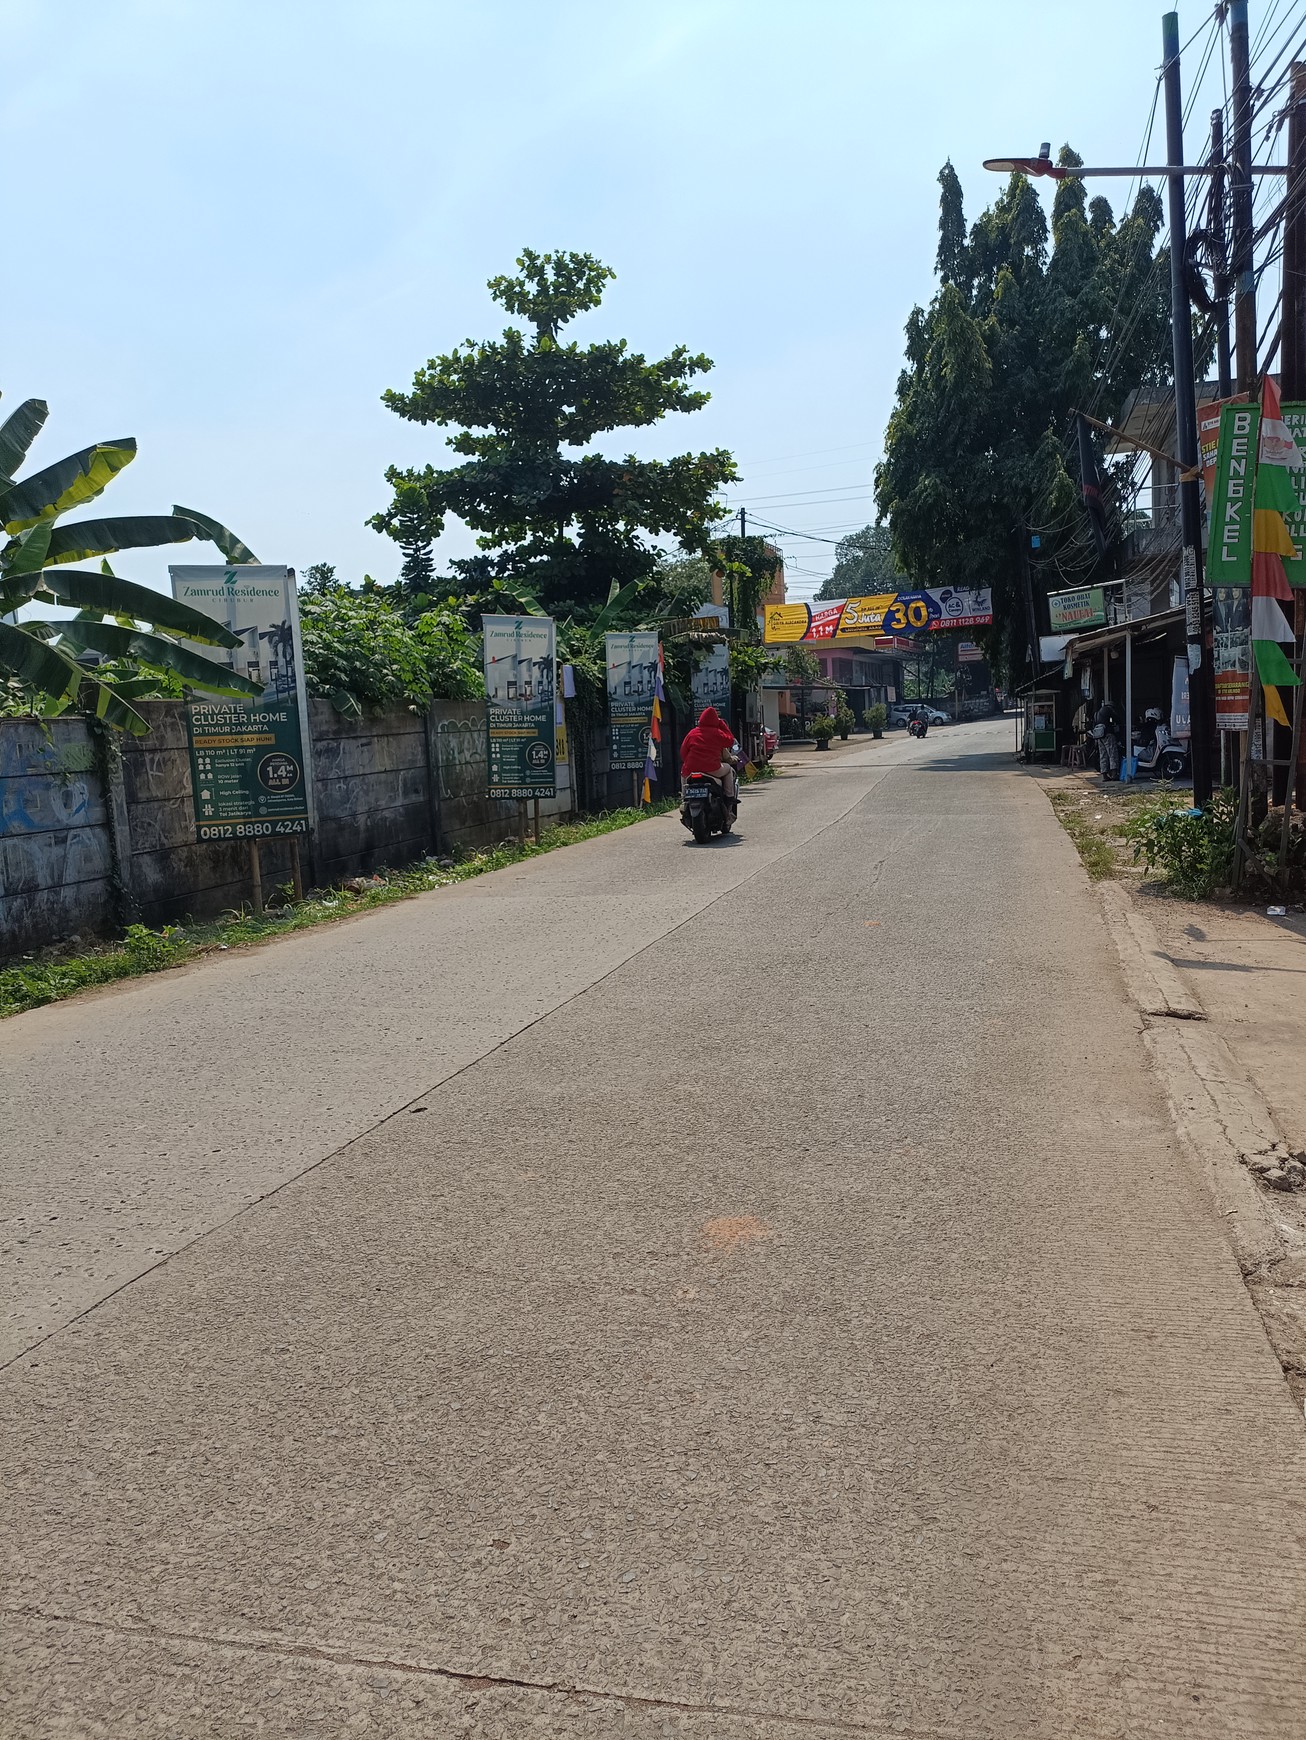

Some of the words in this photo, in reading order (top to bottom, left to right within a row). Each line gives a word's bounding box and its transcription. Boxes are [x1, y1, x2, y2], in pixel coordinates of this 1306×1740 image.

[1202, 441, 1216, 454] STIE
[1222, 413, 1250, 561] BENGKEL
[183, 586, 224, 597] Zamrud
[227, 586, 279, 597] Residence
[1060, 596, 1075, 604] TOKO
[1063, 600, 1089, 610] KOSMETIK
[845, 600, 861, 625] 5
[889, 600, 928, 629] 30
[940, 620, 956, 628] 0811
[959, 618, 974, 626] 1128
[976, 616, 990, 624] 969
[192, 704, 244, 714] PRIVATE
[193, 714, 247, 724] CLUSTER
[251, 713, 287, 722] HOME
[232, 724, 268, 732] JAKARTA
[267, 766, 286, 778] 1.4
[512, 789, 532, 797] 8880
[535, 788, 553, 796] 4241
[201, 826, 233, 839] 0812
[237, 823, 271, 836] 8880
[276, 820, 306, 833] 4241
